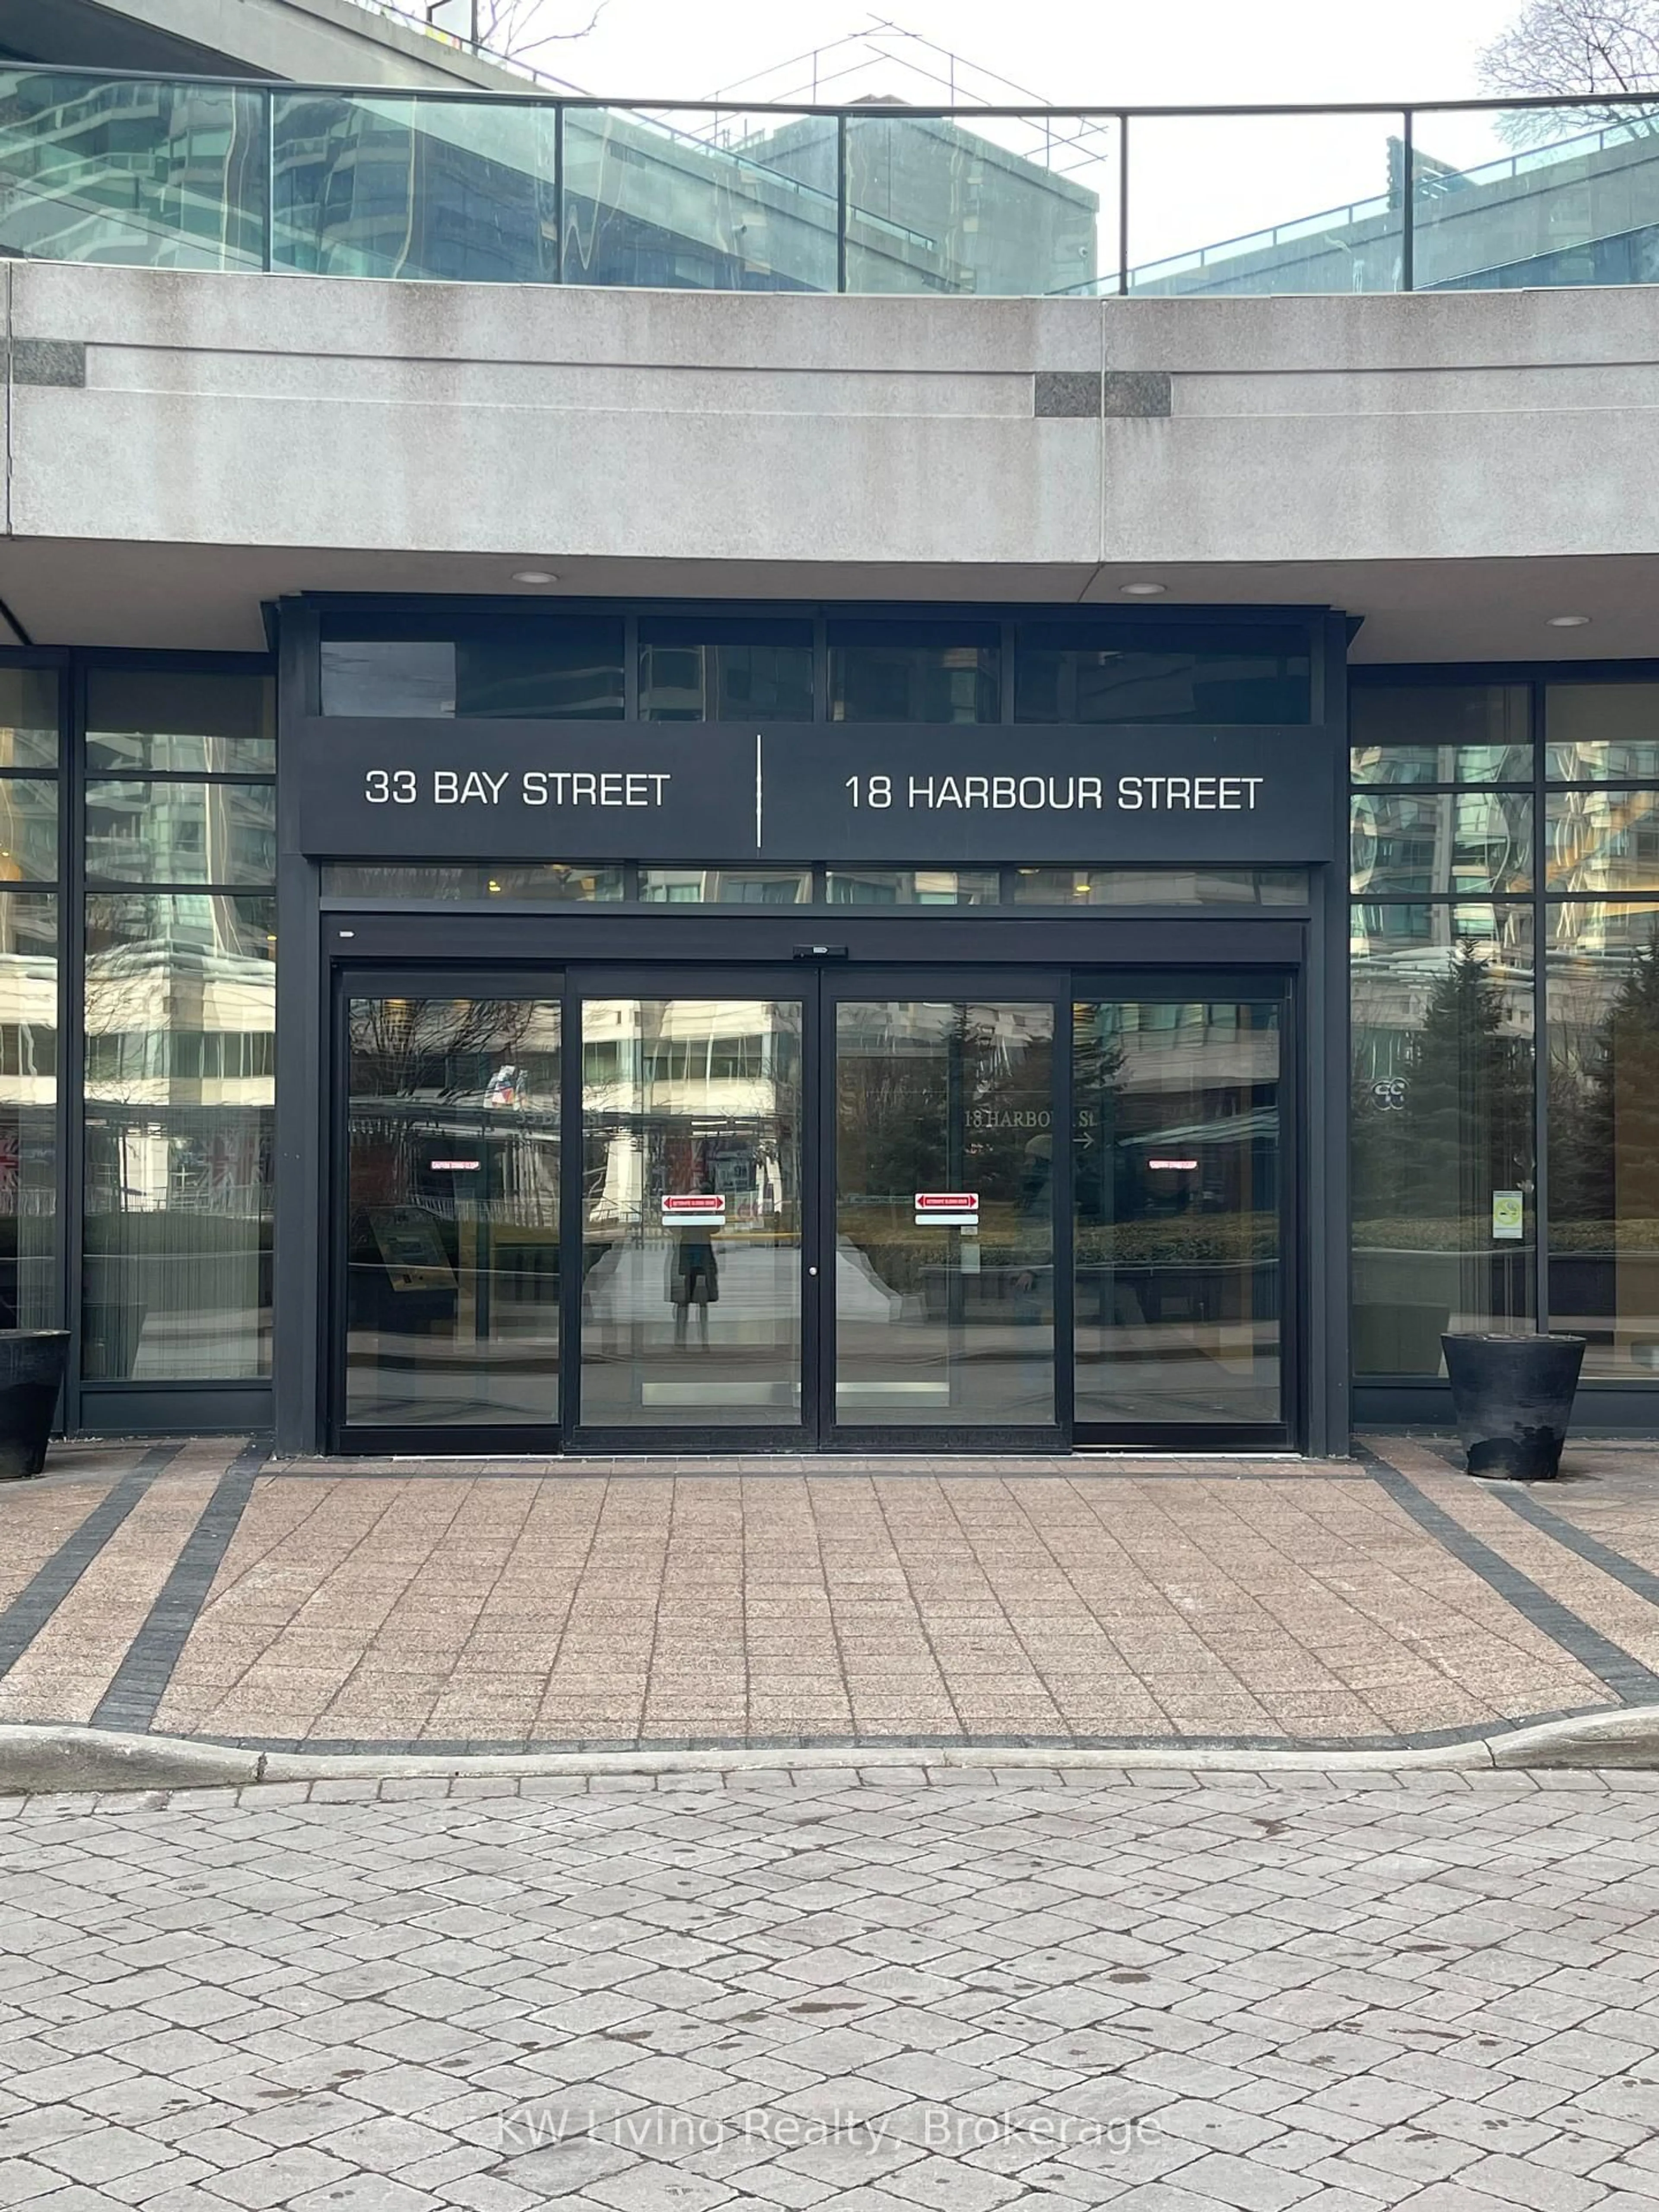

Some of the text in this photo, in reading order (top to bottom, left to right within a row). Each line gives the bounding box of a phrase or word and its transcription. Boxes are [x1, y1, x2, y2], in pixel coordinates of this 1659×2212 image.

[365, 770, 671, 806] 33 BAY STREET
[845, 775, 1264, 810] 18 HARBOUR STREET
[987, 1110, 1076, 1128] HARBO
